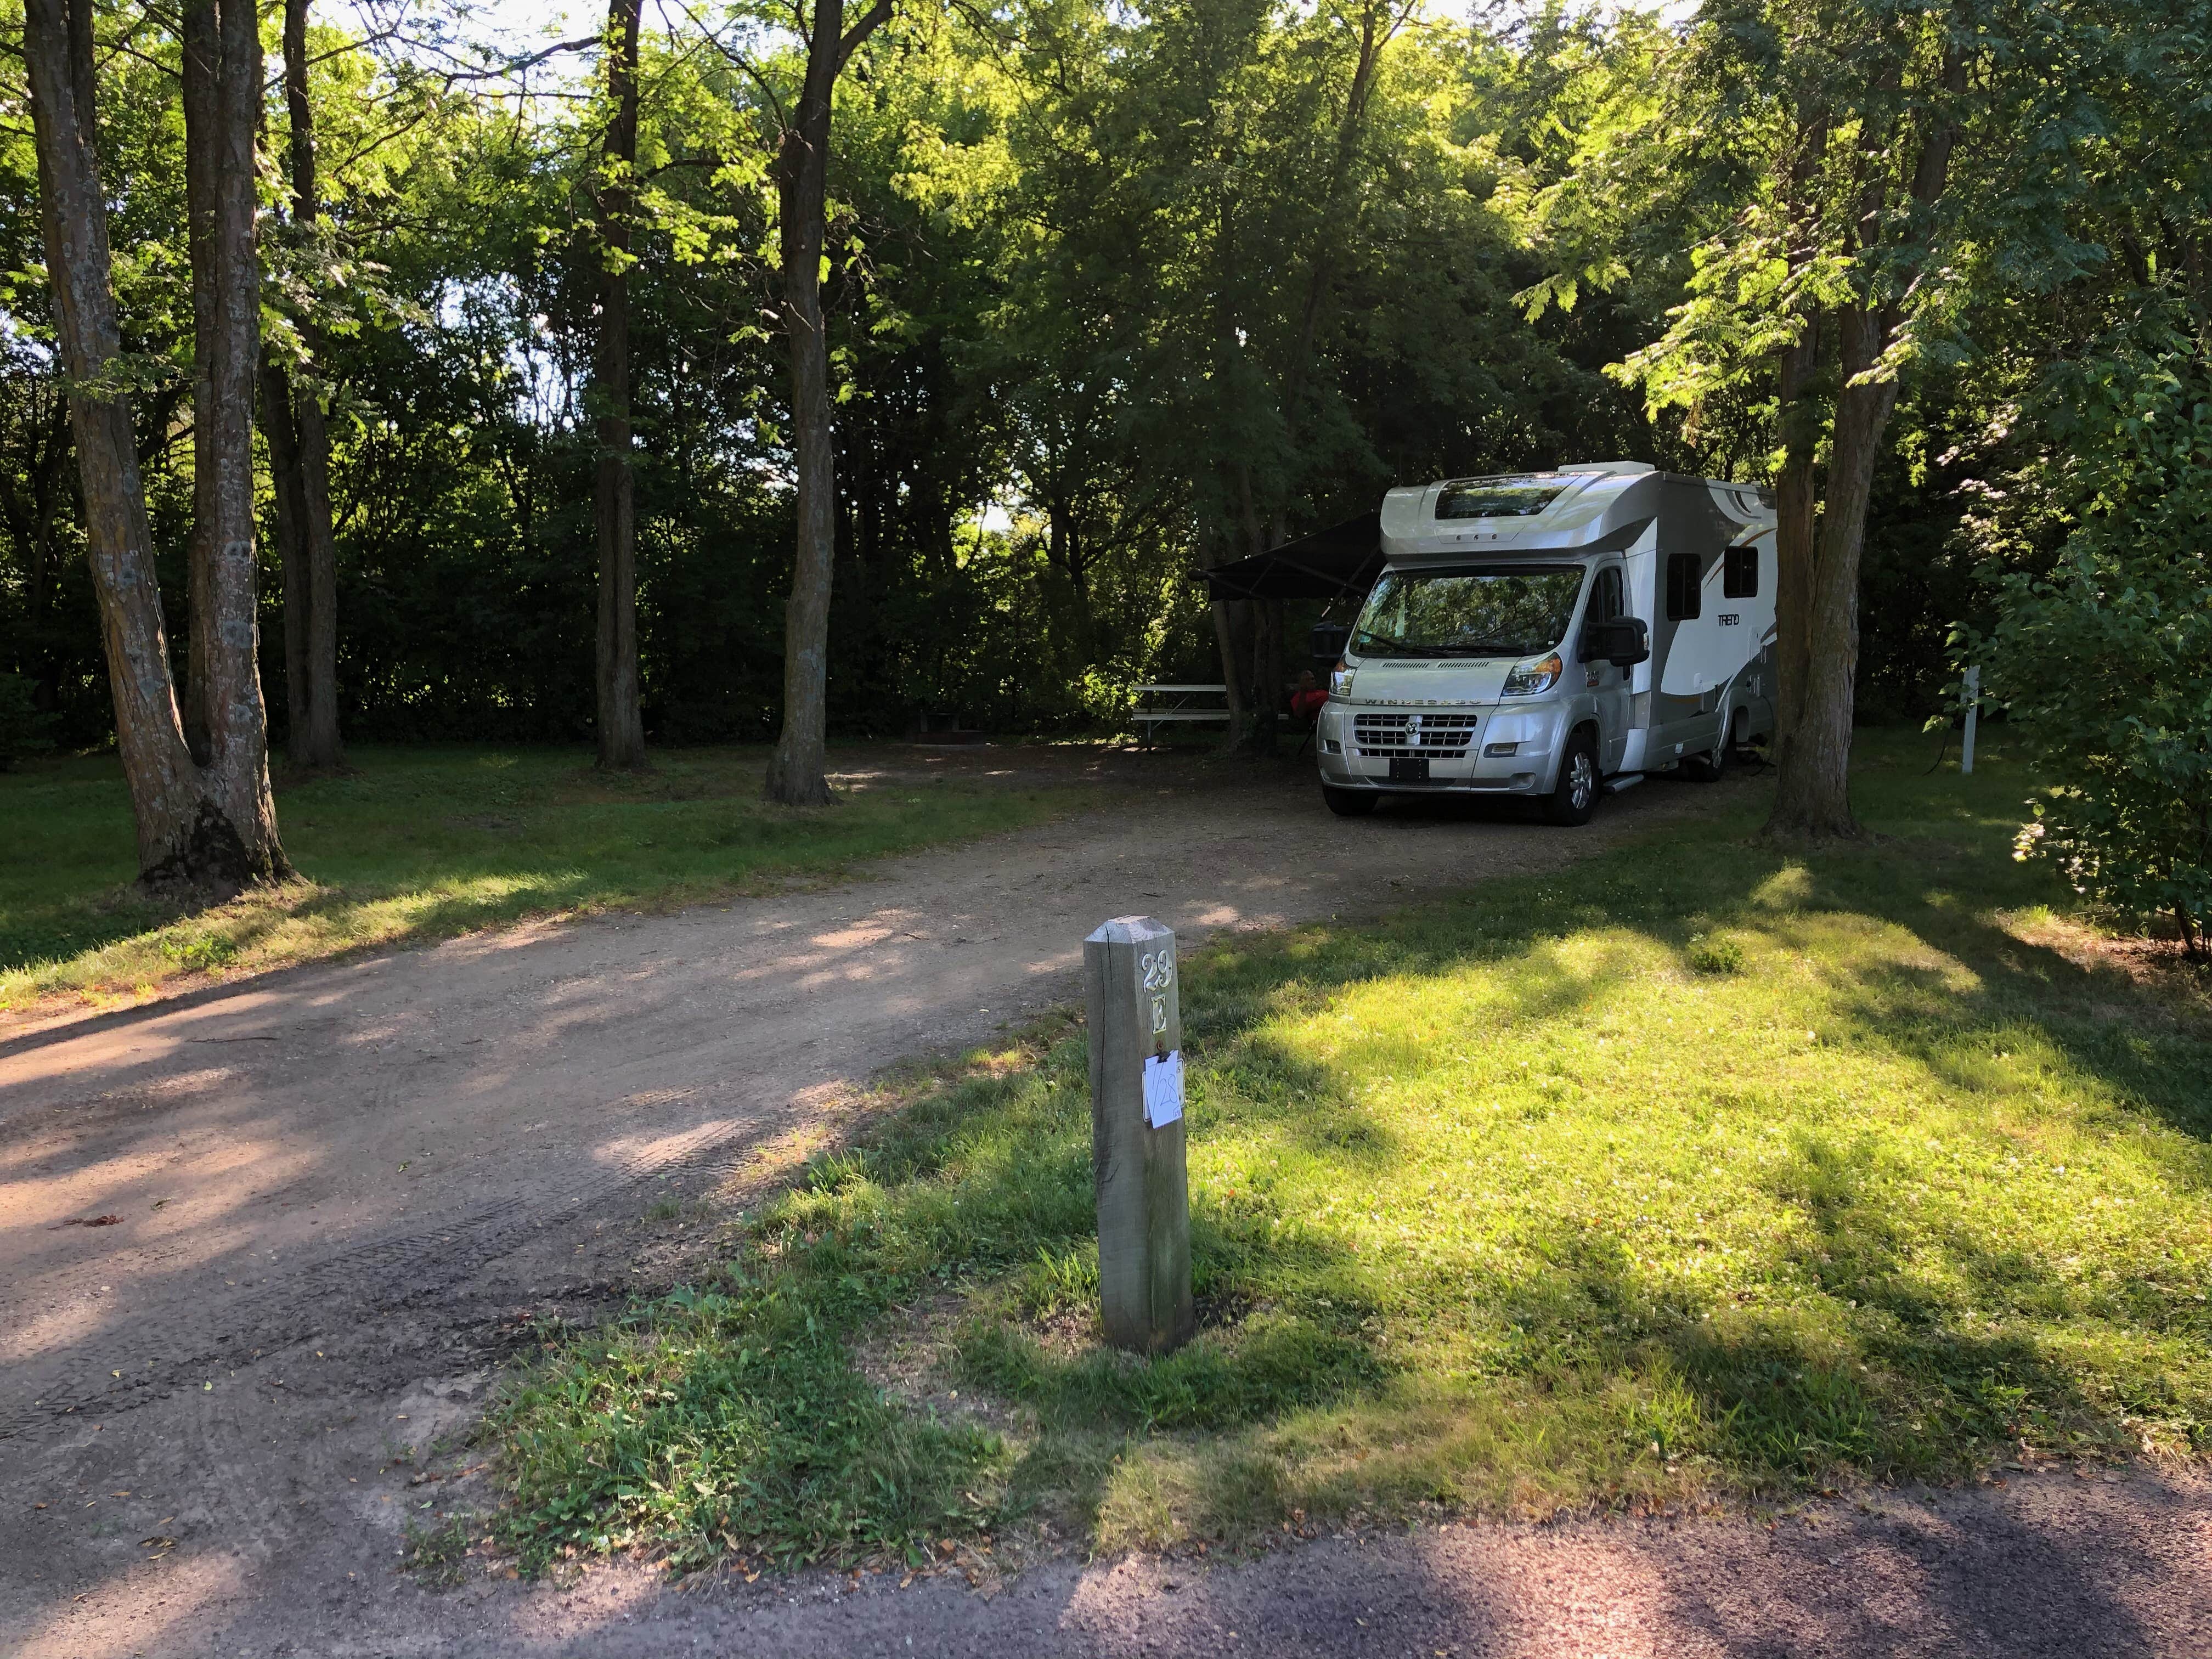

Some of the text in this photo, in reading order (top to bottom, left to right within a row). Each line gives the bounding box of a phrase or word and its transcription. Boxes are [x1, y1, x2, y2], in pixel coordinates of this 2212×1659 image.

[1718, 614, 1740, 626] TREND
[1142, 950, 1173, 993] 29
[1151, 994, 1167, 1034] E
